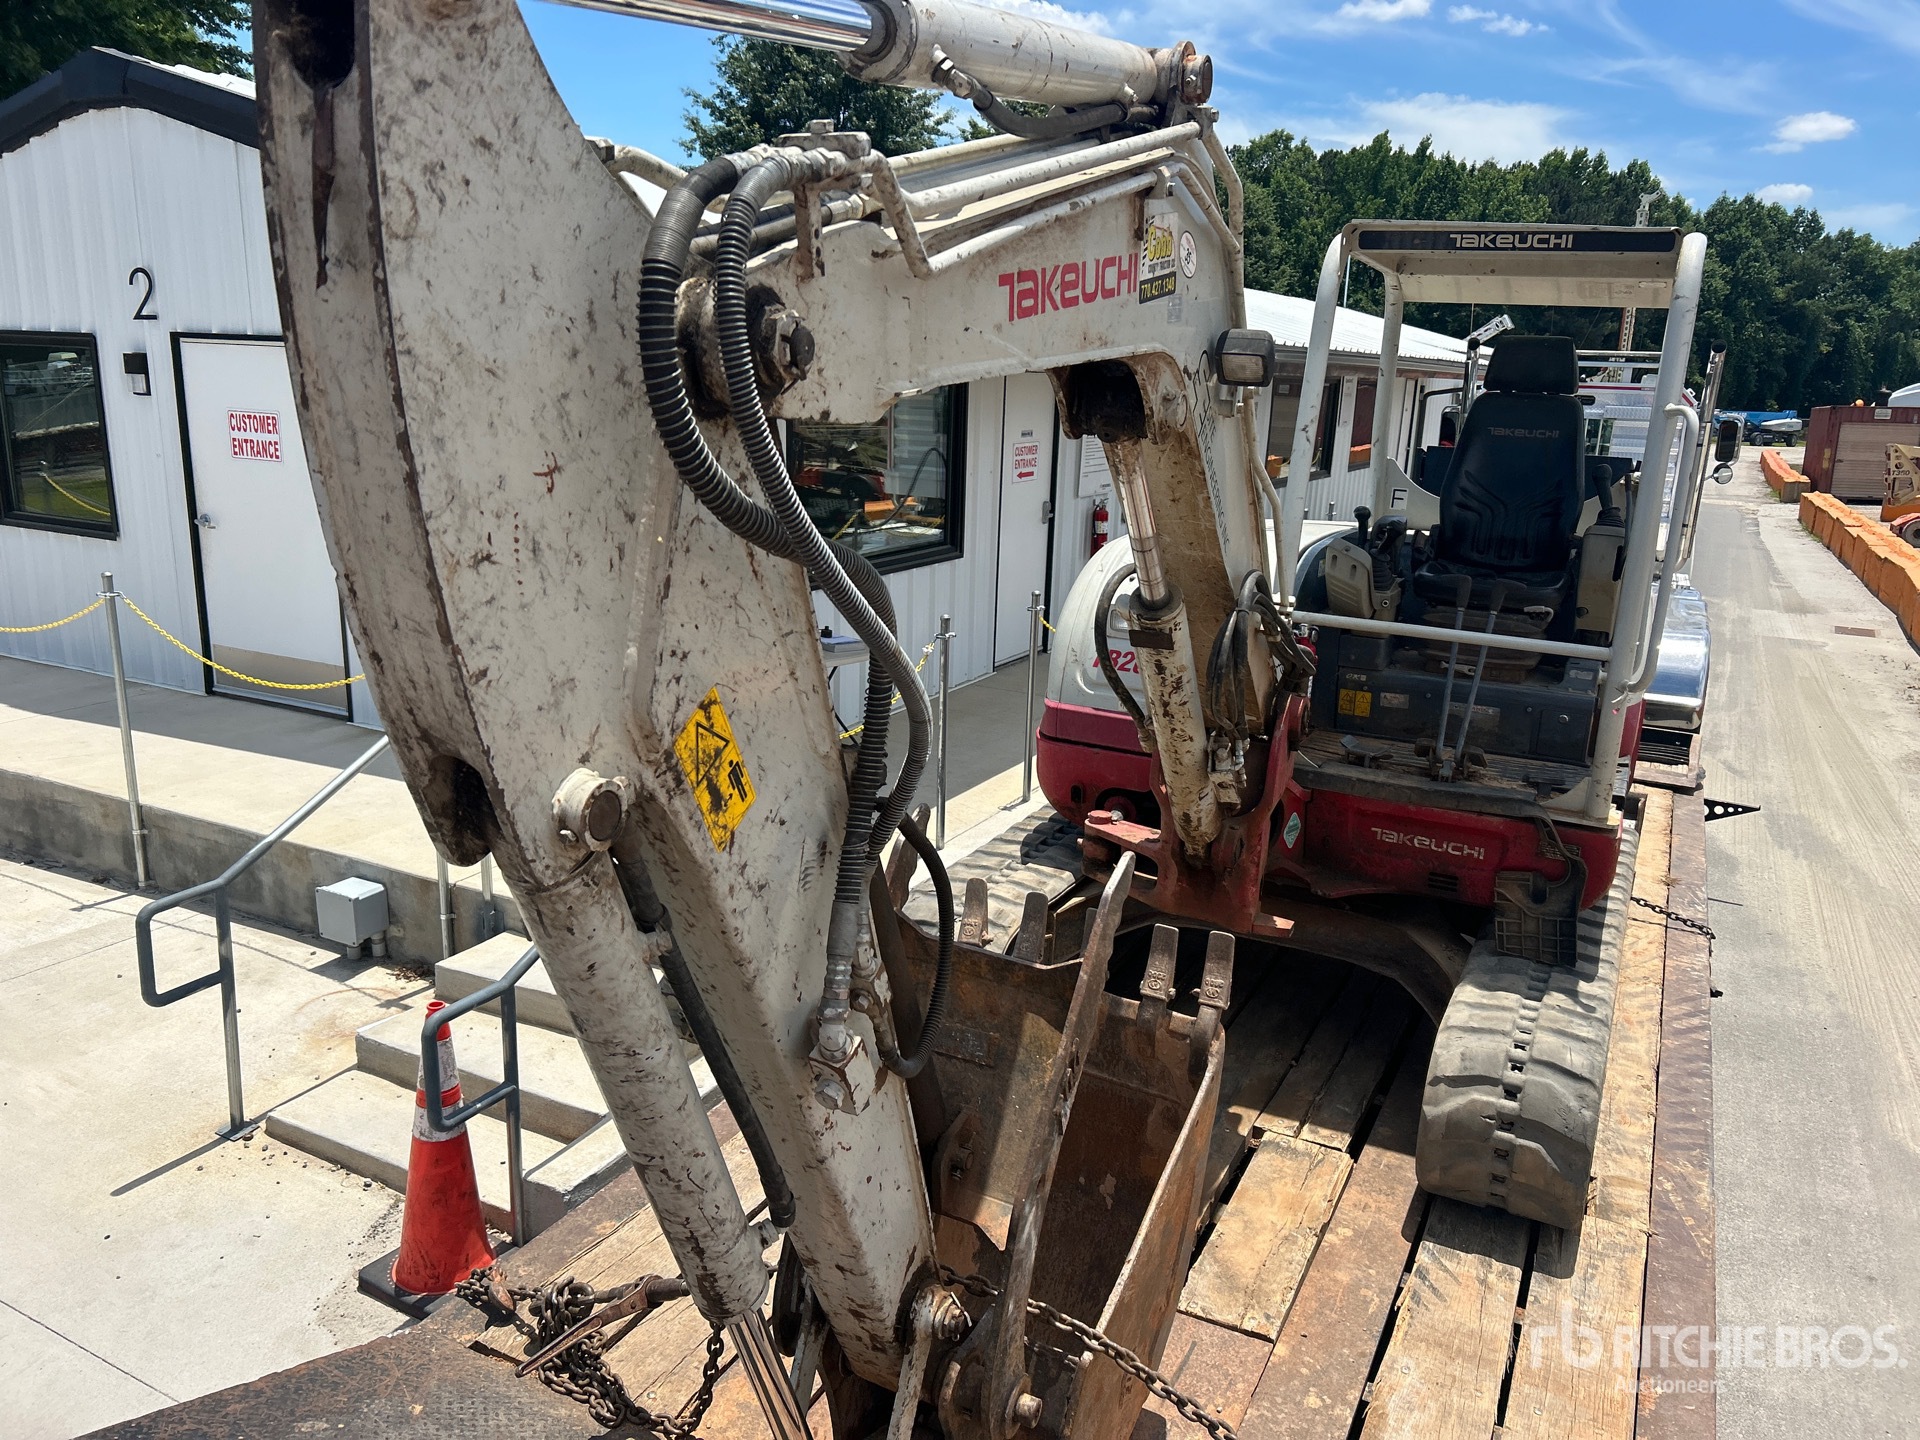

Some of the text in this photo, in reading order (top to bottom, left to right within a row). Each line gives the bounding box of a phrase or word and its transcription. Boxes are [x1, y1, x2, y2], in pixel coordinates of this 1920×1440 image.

[1147, 225, 1173, 262] Cobb
[129, 267, 158, 320] 2
[229, 412, 279, 436] CUSTOMER
[231, 437, 280, 460] ENTRANCE
[1014, 444, 1039, 457] CUSTOMER
[1014, 457, 1038, 470] ENTRANCE
[1390, 488, 1408, 508] F
